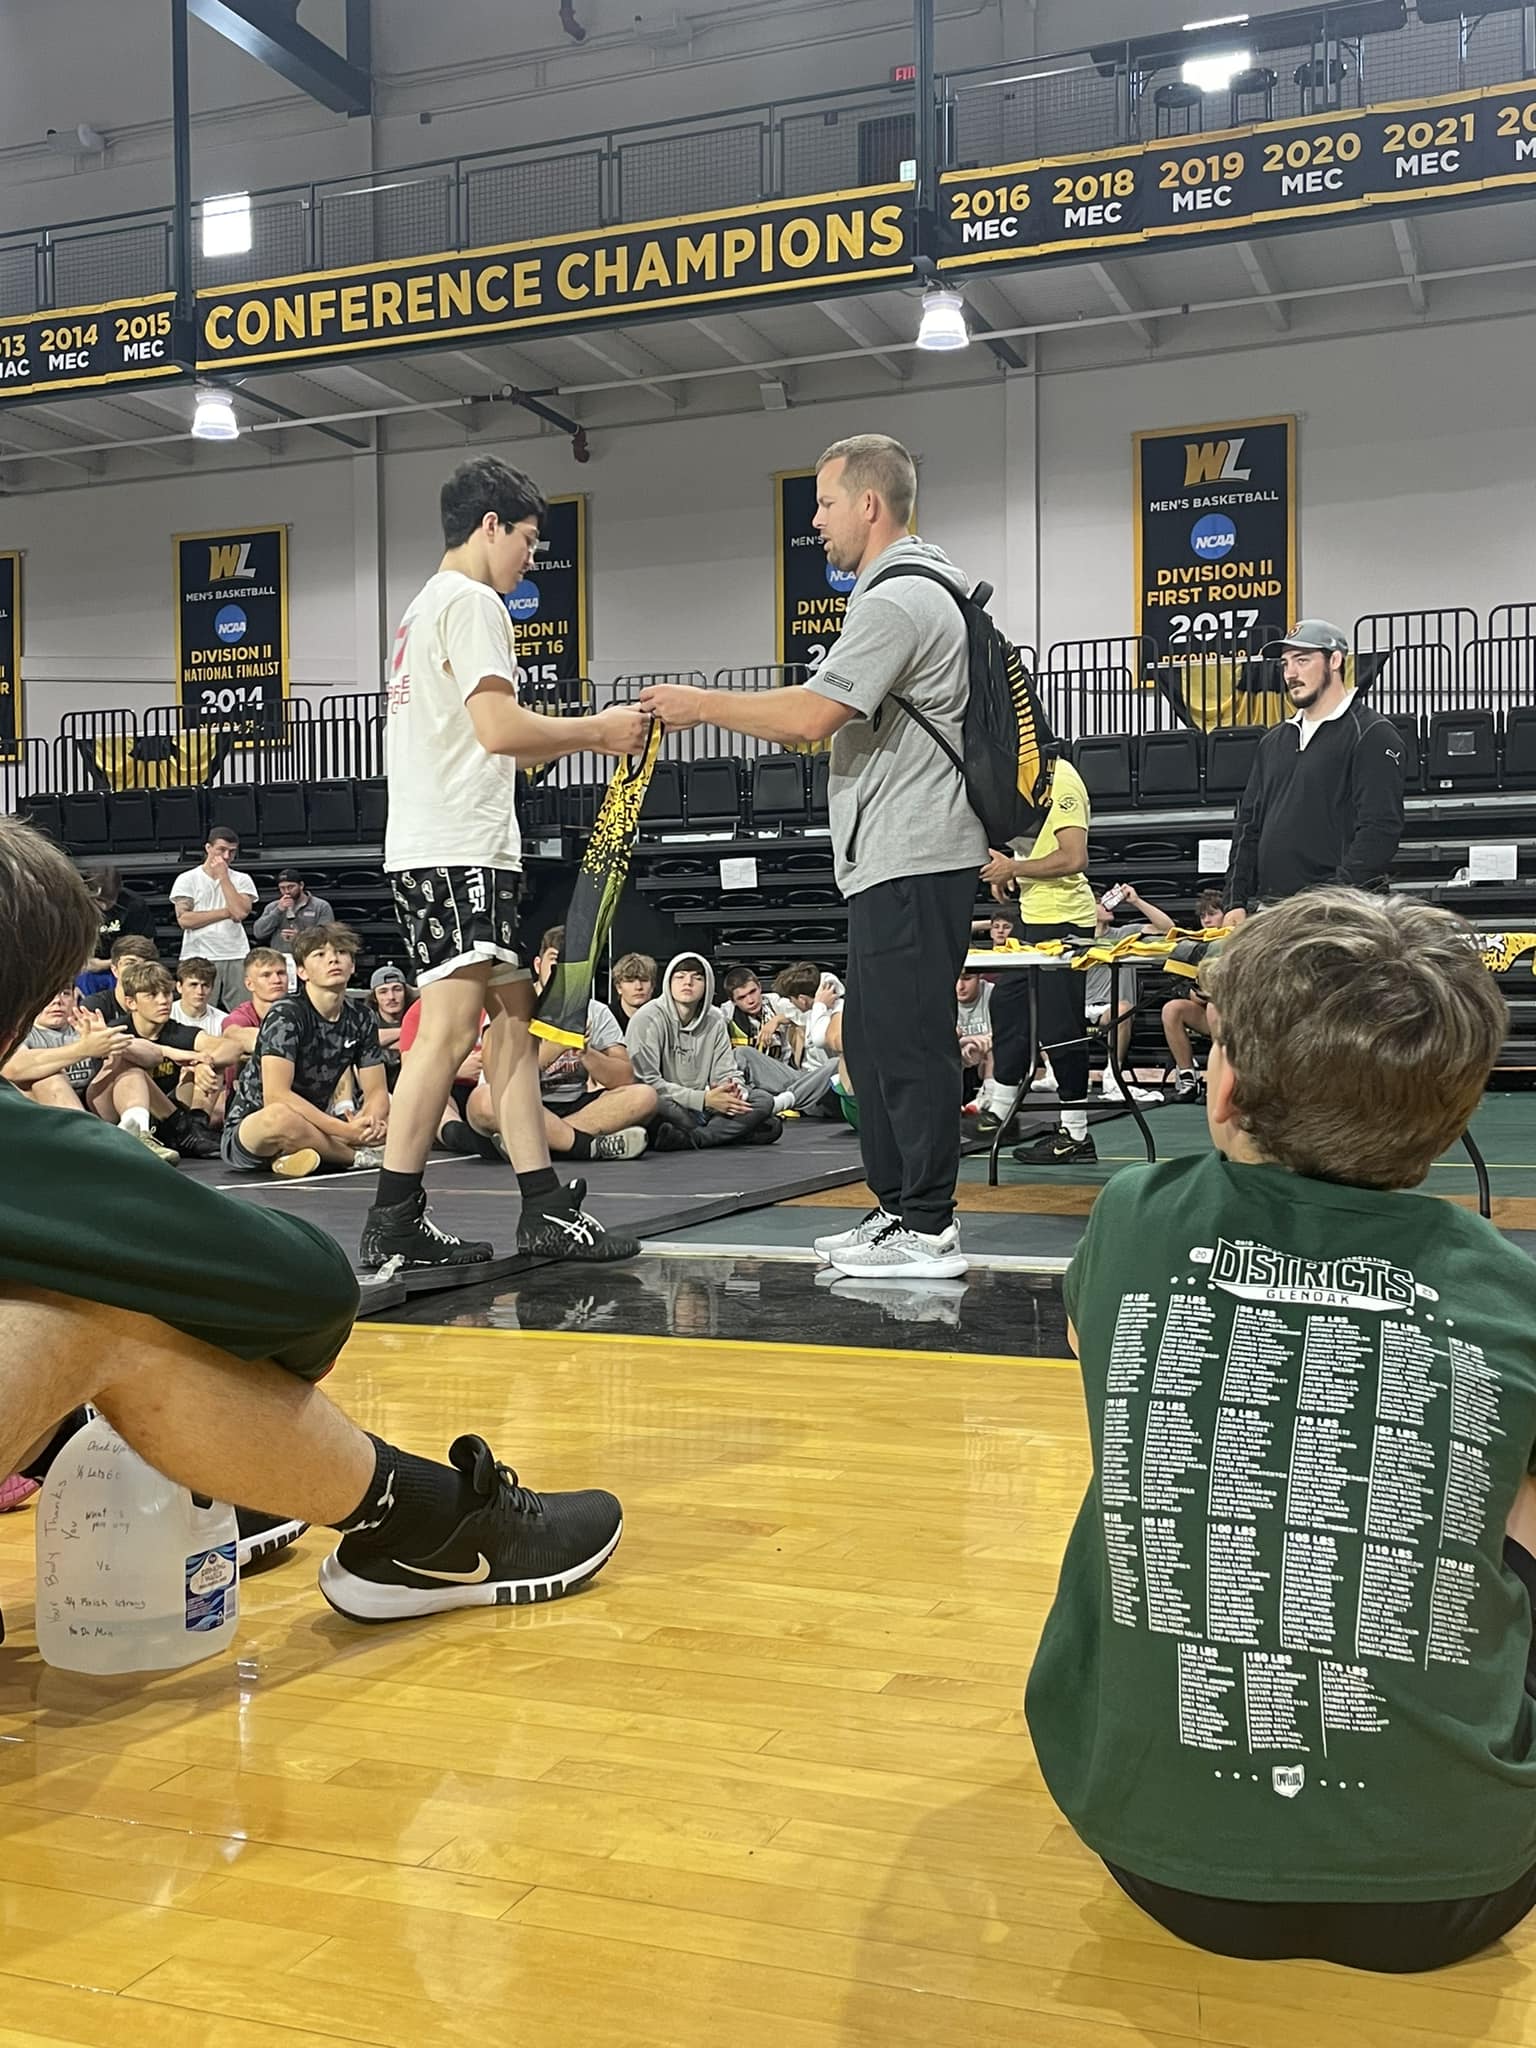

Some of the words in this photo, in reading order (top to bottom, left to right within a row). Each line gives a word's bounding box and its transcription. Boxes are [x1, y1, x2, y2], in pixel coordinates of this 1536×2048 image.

[1383, 113, 1474, 153] 2021
[1263, 133, 1361, 172] 2020
[1159, 152, 1244, 188] 2019
[1396, 150, 1460, 178] MEC
[1053, 170, 1134, 204] 2018
[1282, 168, 1343, 196] MEC
[951, 184, 1030, 220] 2016
[1173, 186, 1232, 213] MEC
[1065, 202, 1122, 228] MEC
[963, 217, 1018, 243] MEC
[204, 259, 542, 350] CONFERENCE
[557, 205, 904, 301] CHAMPIONS
[115, 312, 171, 342] 2015
[40, 324, 98, 352] 2014
[49, 351, 89, 371] MEC
[124, 340, 164, 362] MEC
[1184, 438, 1251, 487] WL
[1150, 499, 1190, 512] MEN'S
[1193, 491, 1279, 508] BASKETBALL
[1195, 533, 1235, 549] NCAA
[208, 543, 257, 582] WL
[1157, 562, 1255, 585] DIVISION
[1260, 560, 1273, 576] II
[186, 592, 213, 602] MEN'S
[215, 586, 276, 600] BASKETBALL
[508, 597, 540, 610] NCAA
[1147, 588, 1202, 607] FIRST
[1209, 580, 1282, 602] ROUND
[217, 621, 247, 635] NCAA
[557, 620, 569, 635] II
[1169, 609, 1259, 643] 2017
[191, 646, 256, 665] DIVISION
[258, 645, 272, 659] II
[546, 639, 565, 655] 16
[184, 665, 234, 683] NATIONAL
[236, 661, 280, 679] FINALIST
[200, 685, 264, 714] 2014
[1208, 1237, 1415, 1307] DISTRICTS
[1187, 1295, 1206, 1305] LBS
[1255, 1308, 1277, 1318] LBS
[1327, 1316, 1349, 1324] LBS
[1400, 1323, 1421, 1334] LBS
[1152, 1400, 1165, 1410] 73
[1166, 1401, 1186, 1411] LBS
[1238, 1409, 1260, 1419] LBS
[1317, 1417, 1339, 1428] LBS
[1396, 1428, 1418, 1440] LBS
[1157, 1517, 1176, 1528] LBS
[1211, 1523, 1232, 1534] 100
[1234, 1525, 1257, 1537] LBS
[1312, 1534, 1335, 1547] LBS
[1391, 1547, 1413, 1560] LBS
[1458, 1561, 1475, 1574] LBS
[1181, 1643, 1198, 1655] 132
[1199, 1646, 1219, 1658] LBS
[1271, 1653, 1293, 1665] LBS
[1346, 1664, 1368, 1678] LBS
